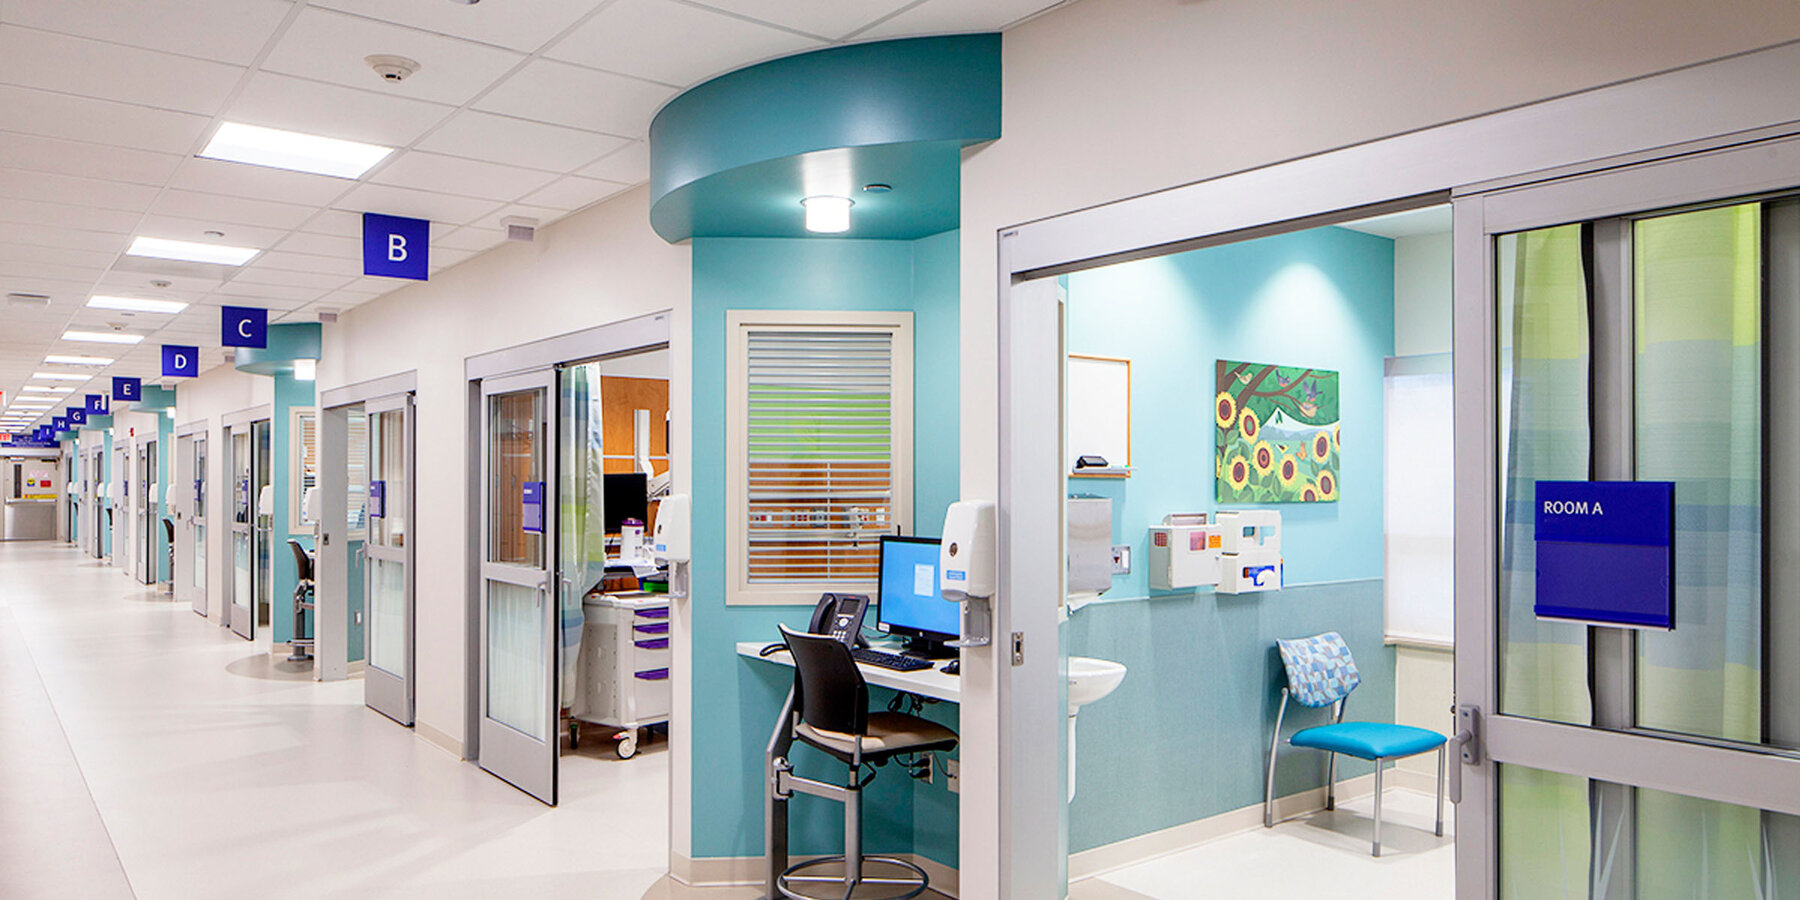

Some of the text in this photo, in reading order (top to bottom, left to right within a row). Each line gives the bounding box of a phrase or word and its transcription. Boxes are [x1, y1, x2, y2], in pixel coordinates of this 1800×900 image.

[388, 234, 408, 262] B
[238, 319, 252, 338] C
[174, 354, 187, 369] D
[123, 384, 132, 396] E
[94, 400, 101, 410] F
[72, 411, 81, 421] G
[57, 421, 65, 429] H
[1543, 500, 1604, 515] ROOM A
